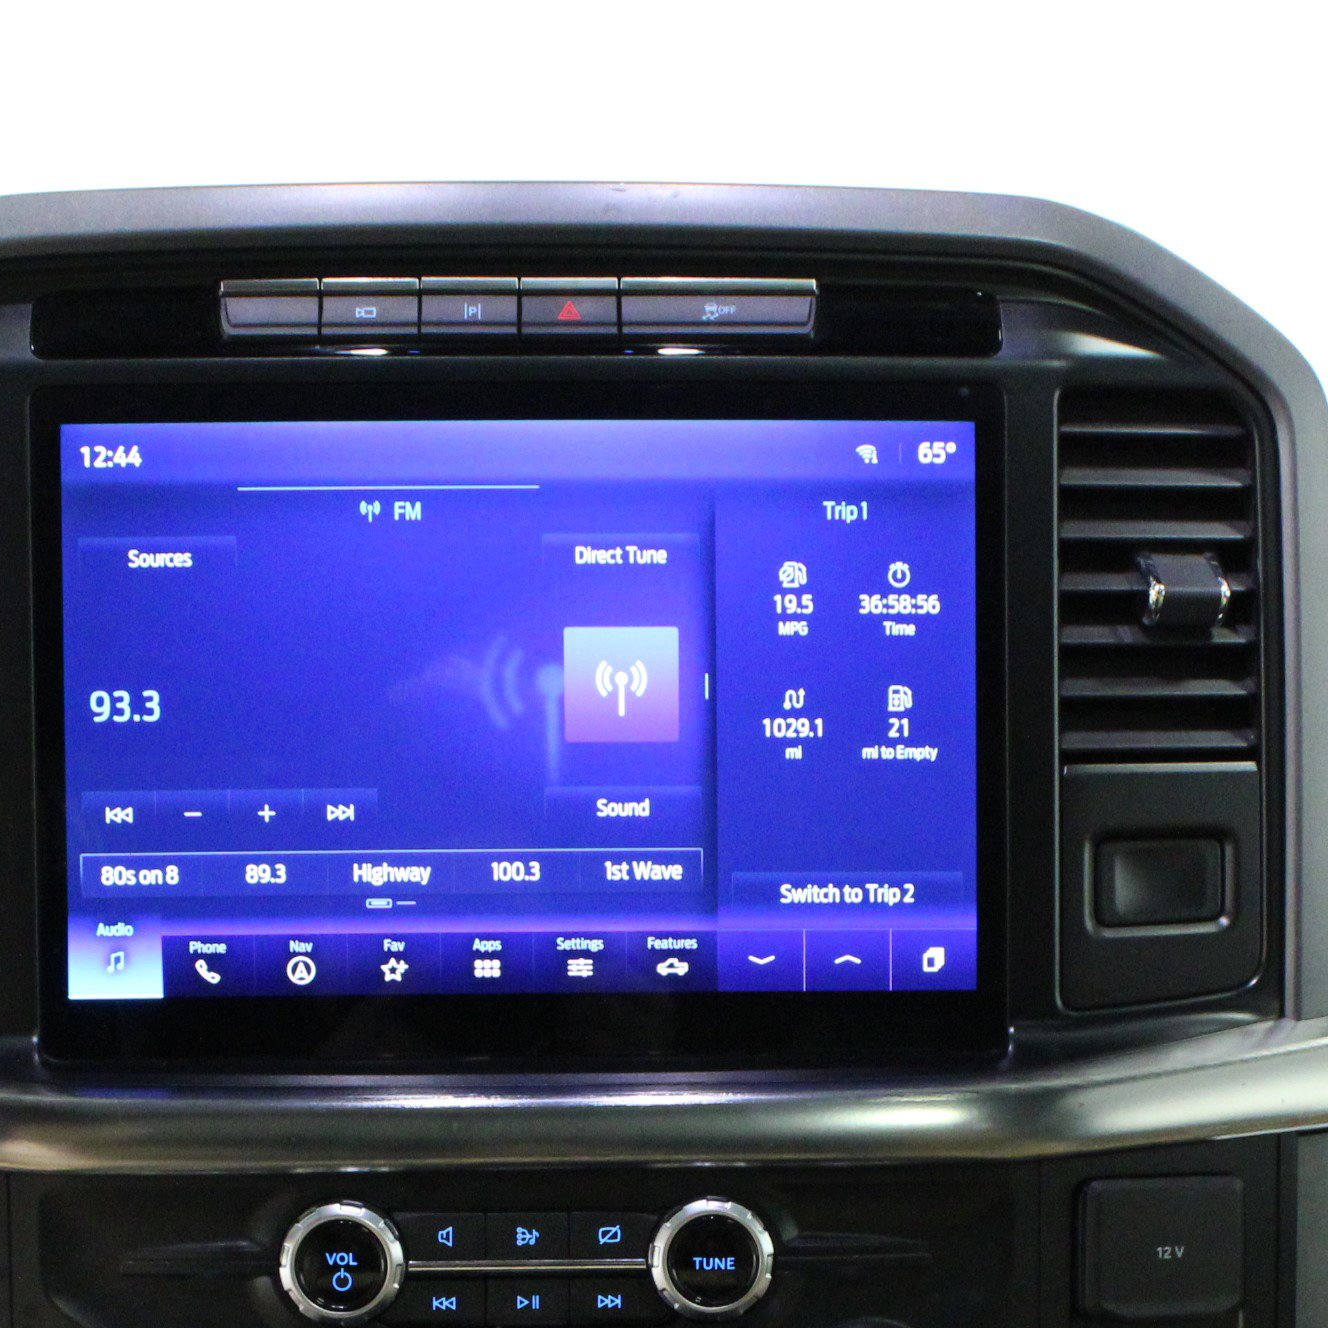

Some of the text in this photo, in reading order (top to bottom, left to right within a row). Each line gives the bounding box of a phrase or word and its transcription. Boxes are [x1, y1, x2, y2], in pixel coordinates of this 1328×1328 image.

[718, 306, 736, 314] OFF
[80, 445, 142, 468] 12:44
[918, 441, 957, 464] 65°
[393, 501, 422, 521] FM
[823, 501, 868, 523] Trip 1
[127, 549, 193, 569] Sources
[574, 546, 667, 564] Direct Tune
[773, 594, 813, 614] 19.5
[859, 594, 940, 614] 36:58:56
[778, 621, 808, 636] MPG
[883, 621, 915, 636] Time
[89, 689, 161, 723] 93.3
[762, 718, 823, 737] 1029.1
[888, 718, 909, 737] 21
[785, 745, 802, 760] mi
[862, 745, 938, 761] mi to Empty
[596, 798, 650, 817] Sound
[100, 865, 179, 885] 80s on 8
[245, 864, 287, 884] 89.3
[352, 863, 431, 885] Highway
[491, 861, 541, 881] 100.3
[604, 861, 683, 881] 1st Wave
[779, 883, 915, 906] Switch to Trip 2
[96, 922, 134, 938] Audio
[189, 940, 227, 955] Phone
[289, 940, 313, 953] Nav
[383, 939, 405, 952] Fav
[472, 939, 502, 953] Apps
[556, 937, 604, 952] Settings
[647, 937, 698, 951] Features
[326, 1252, 358, 1266] VOL
[1156, 1246, 1184, 1259] 12 V
[693, 1257, 735, 1271] TUNE
